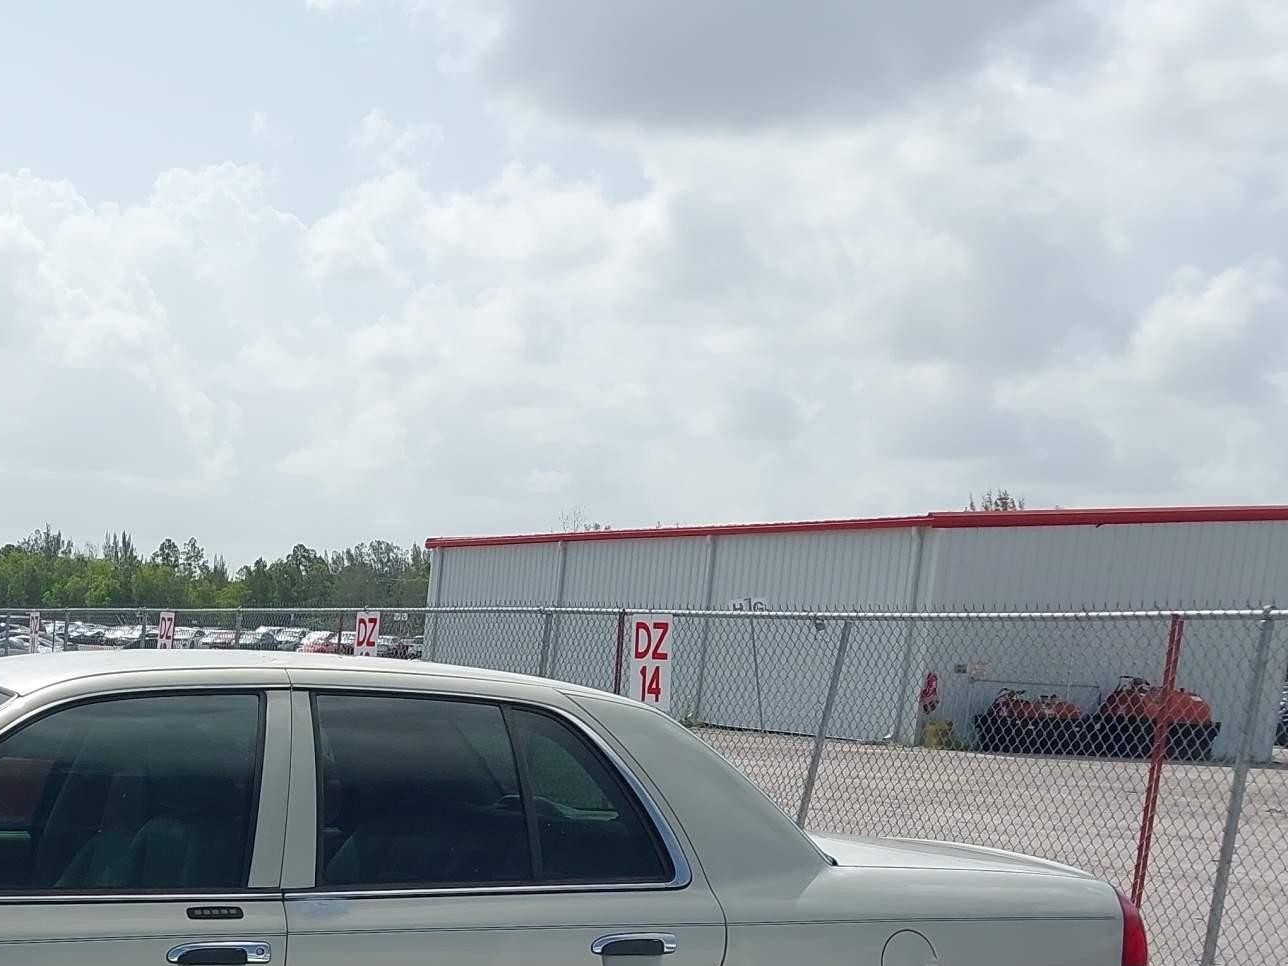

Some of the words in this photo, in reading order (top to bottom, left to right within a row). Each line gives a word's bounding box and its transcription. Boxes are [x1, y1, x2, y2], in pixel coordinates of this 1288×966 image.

[159, 617, 173, 640] DZ
[356, 618, 378, 647] DZ
[634, 621, 669, 660] DZ
[639, 665, 662, 702] 14
